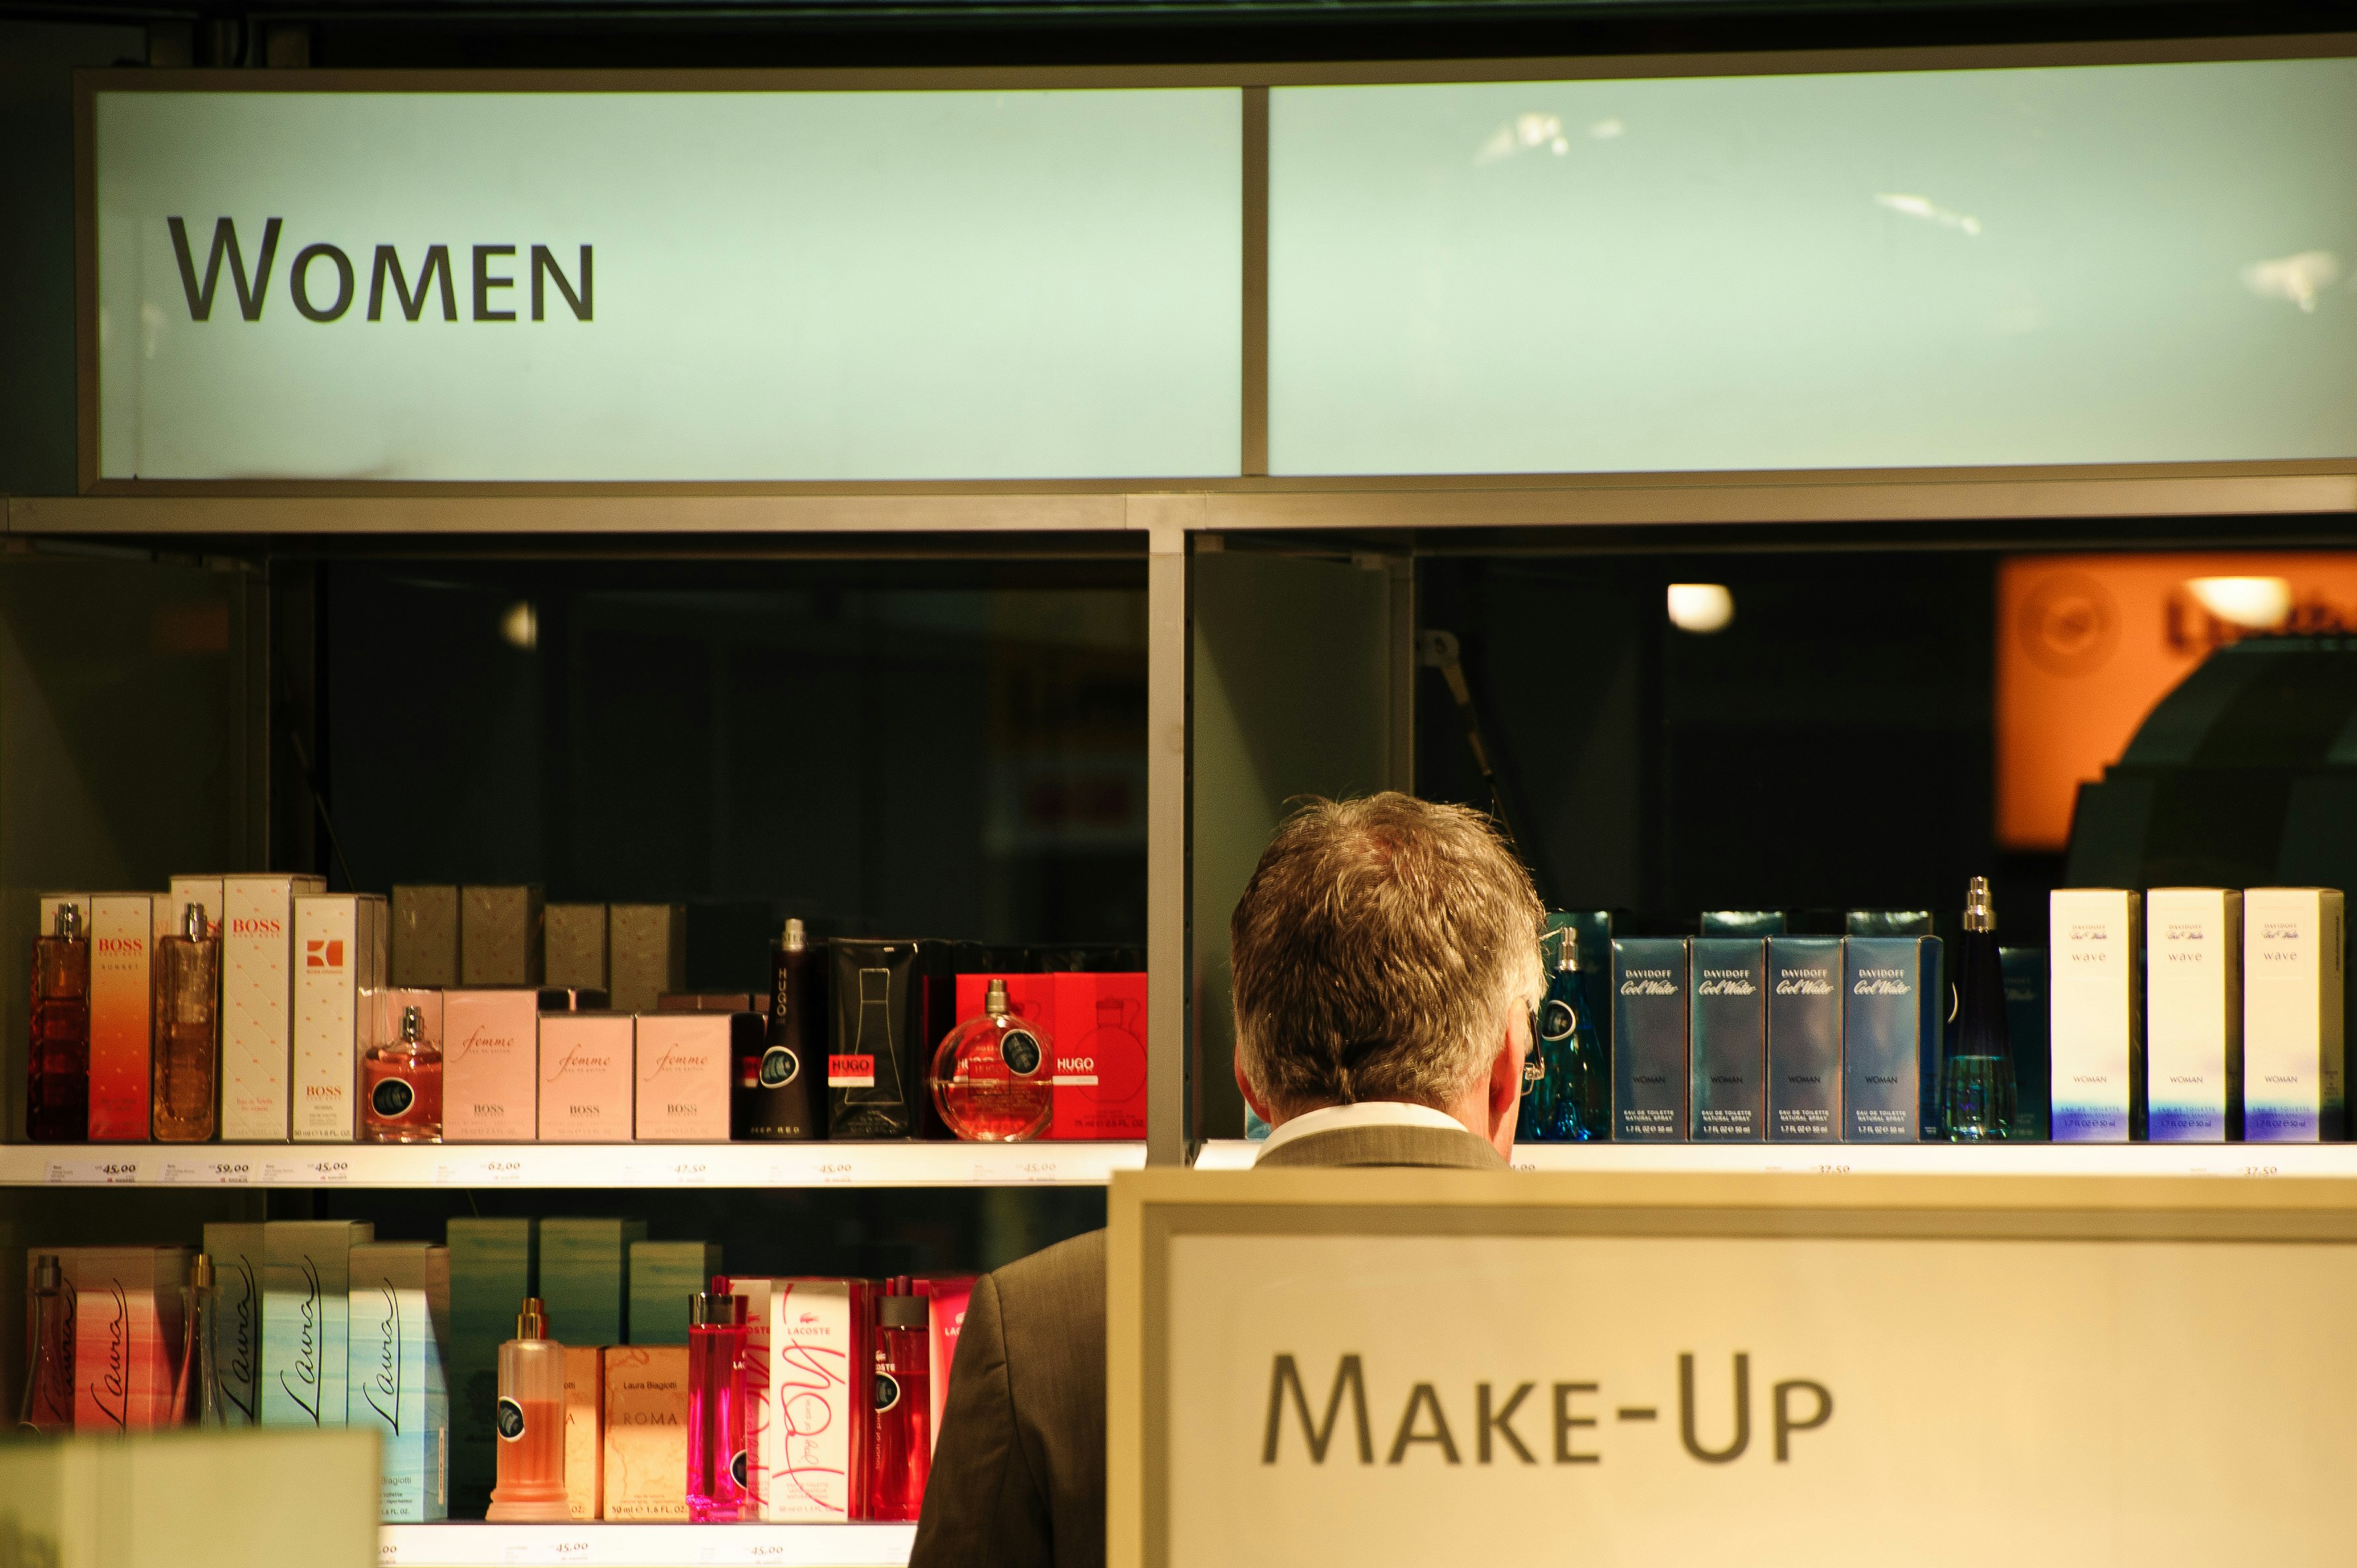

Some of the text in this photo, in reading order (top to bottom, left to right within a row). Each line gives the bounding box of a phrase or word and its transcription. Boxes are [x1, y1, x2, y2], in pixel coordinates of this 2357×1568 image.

[167, 216, 594, 323] WOMEN
[233, 919, 281, 932] BOSS
[99, 938, 143, 952] BOSS
[2072, 953, 2106, 962] wave
[2168, 953, 2202, 962] wave
[2264, 952, 2297, 961] wave
[1625, 970, 1672, 978] DAVIDOFF
[1703, 970, 1750, 978] DAVIDOFF
[1781, 969, 1828, 978] DAVIDOFF
[1859, 969, 1905, 978] DAVIDOFF
[776, 968, 787, 1016] HUGO
[1621, 980, 1679, 995] Cool Water
[1699, 980, 1756, 995] Cool Water
[1776, 979, 1834, 995] Cool Water
[1854, 979, 1912, 995] Cool Water
[450, 1024, 514, 1063] femme
[546, 1044, 611, 1082] femme
[644, 1043, 708, 1081] femme
[832, 1059, 869, 1070] HUGO
[1057, 1057, 1094, 1070] HUGO
[306, 1086, 341, 1096] BOSS
[474, 1104, 504, 1114] BOSS
[570, 1104, 599, 1114] BOSS
[667, 1104, 697, 1113] BOSS
[280, 1254, 321, 1427] Laura
[91, 1277, 130, 1434] Laura
[364, 1276, 401, 1436] Laura
[623, 1381, 677, 1391] Laura Biagiotti
[1260, 1351, 1835, 1466] MAKE-UP
[623, 1412, 677, 1425] ROMA
